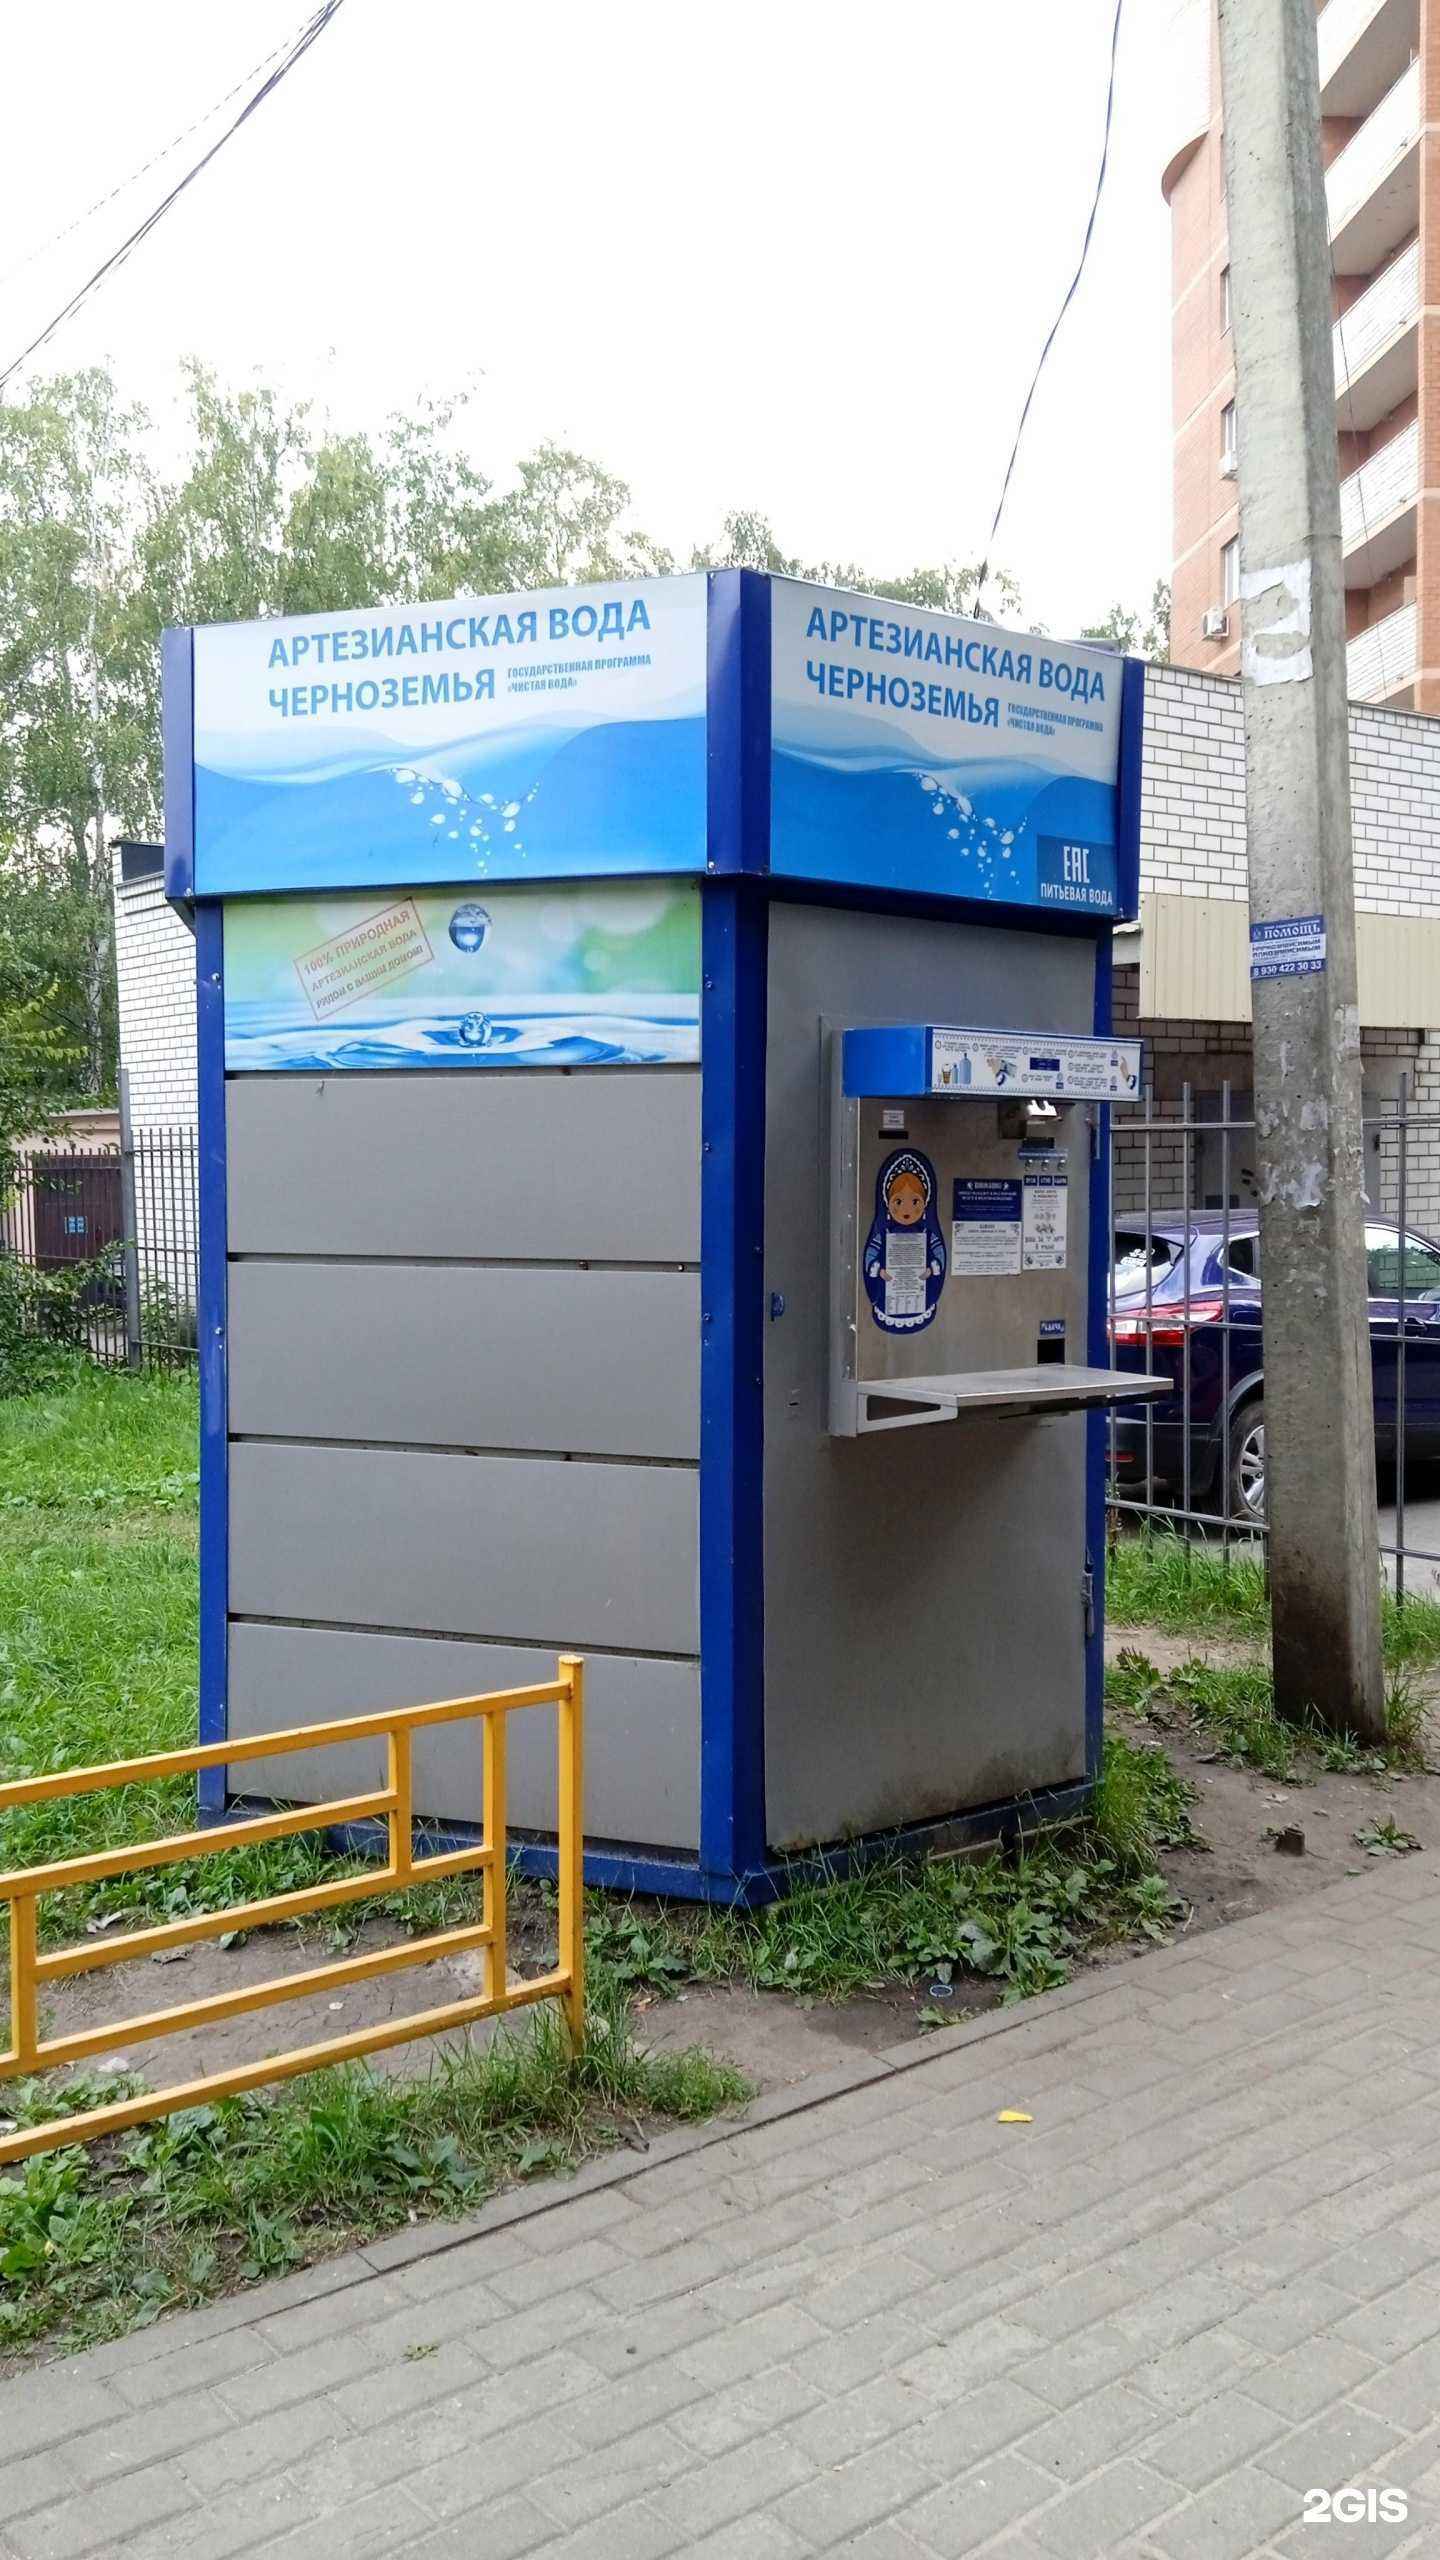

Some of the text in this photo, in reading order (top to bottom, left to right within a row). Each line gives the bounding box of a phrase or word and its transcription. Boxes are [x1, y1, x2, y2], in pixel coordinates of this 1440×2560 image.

[267, 598, 652, 669] АРТЕЗИАНСКАЯ ВОДА
[806, 606, 1106, 704] АРТЕЗИАНСКАЯ ВОДА
[267, 668, 497, 718] ЧЕРНОЗЕМЬЯ
[507, 653, 652, 680] ГОСУДАРСТВЕННАЯ ПРОГРАММА
[805, 659, 1000, 729] ЧЕРНОЗЕМЬЯ
[1040, 882, 1113, 907] ПИТЬЕВАЯ ВОДА
[303, 910, 411, 976] 100% ПРИРОДНАЯ
[312, 928, 417, 993] АРТЕЗИАНСКАЯ ВОДА
[1264, 923, 1321, 939] ПОМОЩЬ
